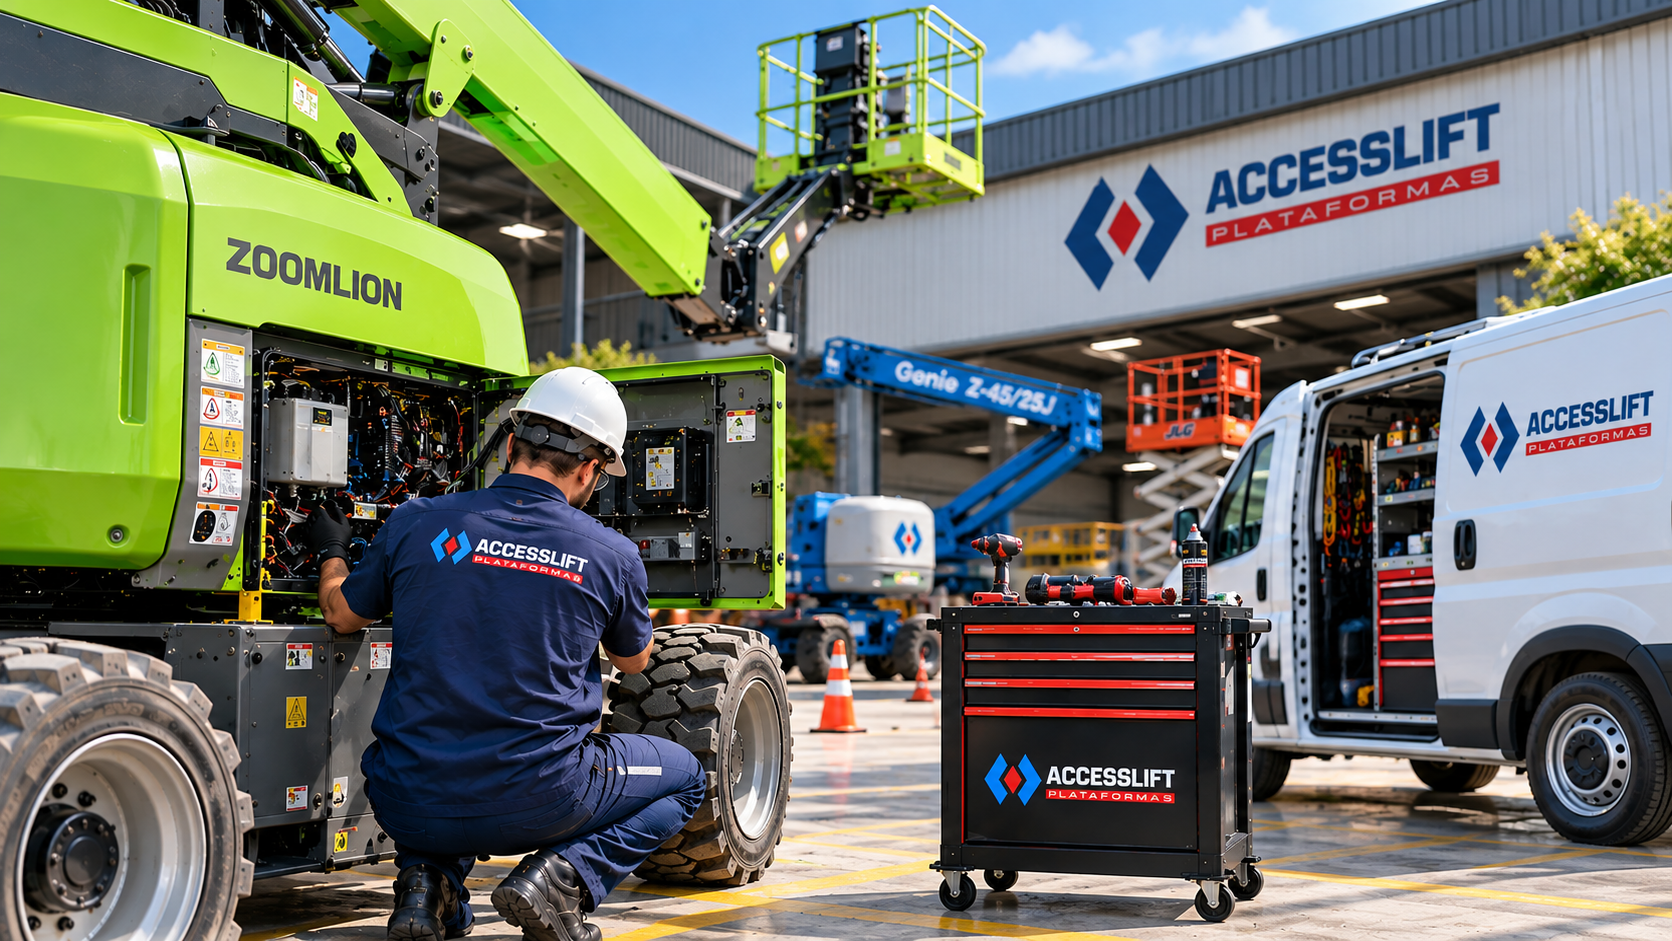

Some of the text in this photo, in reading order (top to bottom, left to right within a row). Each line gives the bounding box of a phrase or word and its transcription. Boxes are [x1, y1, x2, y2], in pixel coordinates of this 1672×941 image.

[1205, 102, 1500, 214] ACCESSLIFT
[1211, 167, 1490, 242] PLATAFORMAS
[226, 237, 403, 311] ZOOMLION
[895, 360, 1057, 416] Genie Z-45/25J
[1164, 421, 1196, 441] JLG
[1526, 390, 1654, 437] ACCESSLIFT
[1528, 424, 1649, 455] PLATAFORMAS
[475, 538, 589, 573] ACCESSLIFT
[1046, 766, 1175, 789] ACCESSLIFT
[1047, 790, 1173, 803] PLATAFORMAS
